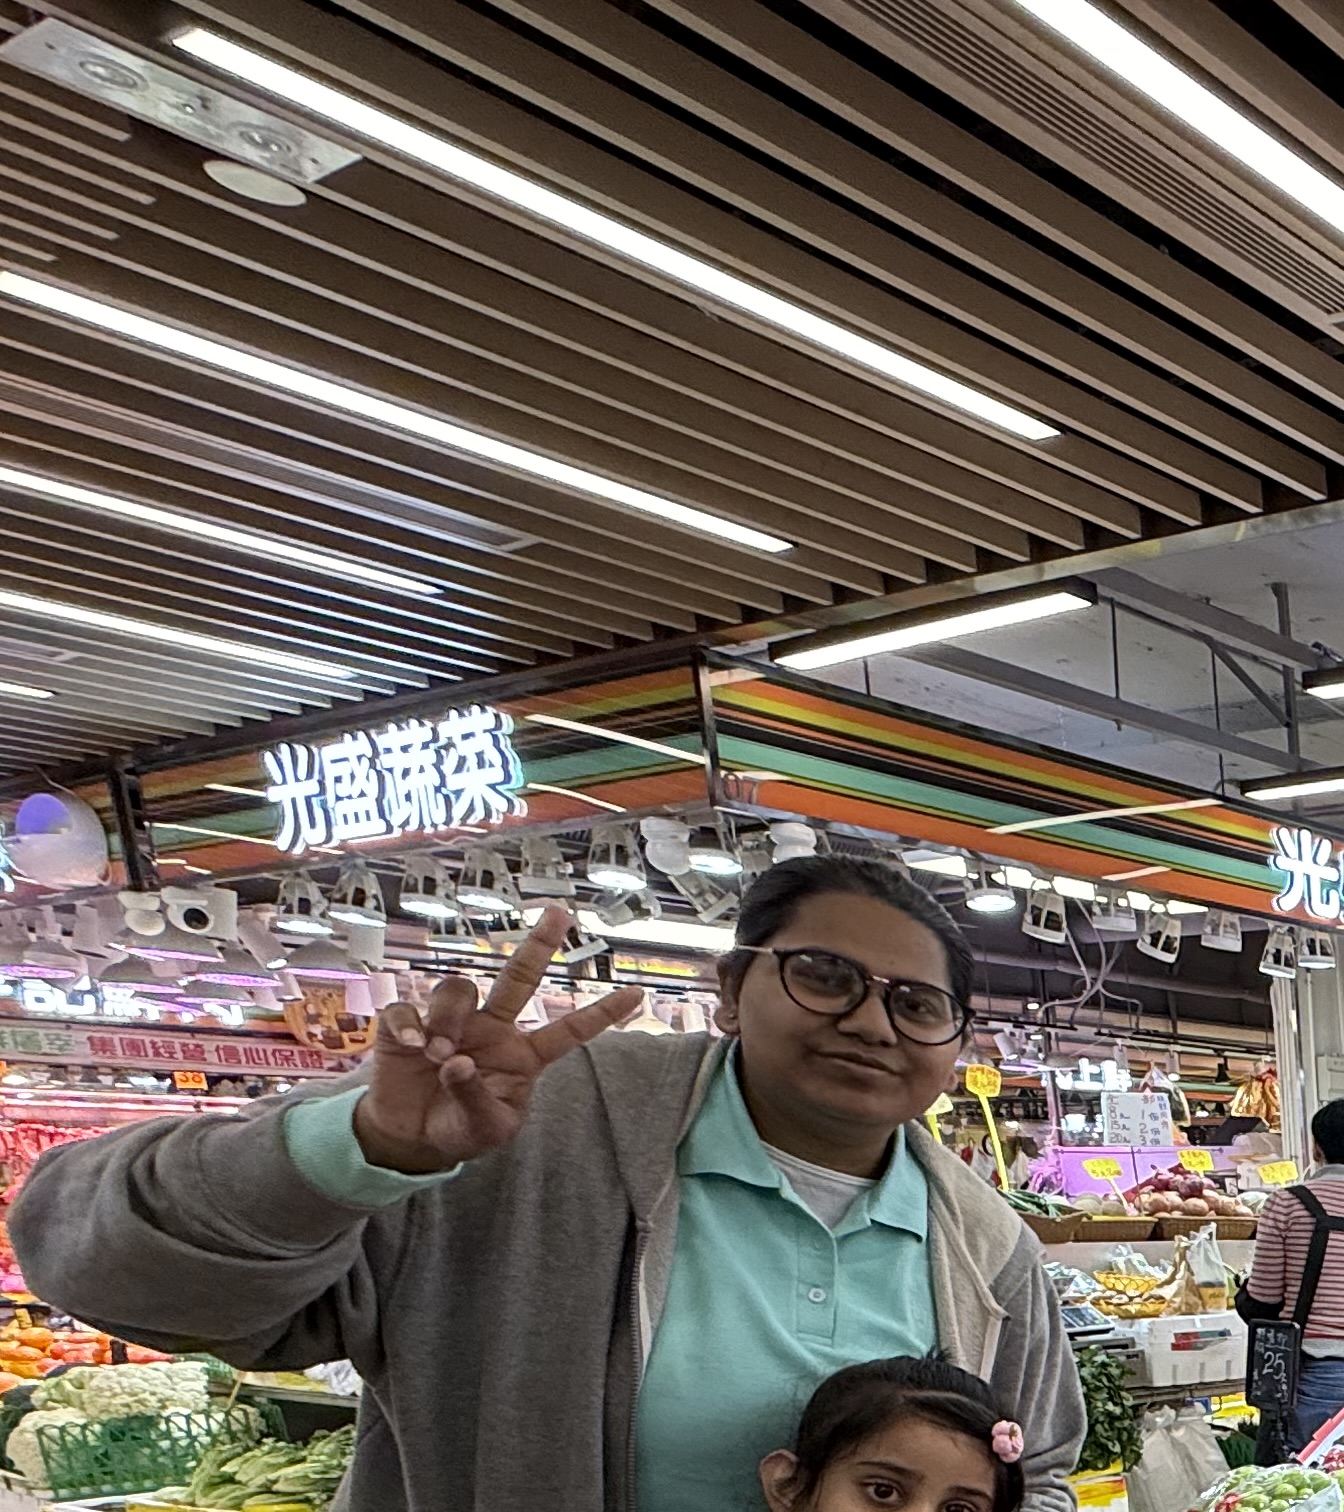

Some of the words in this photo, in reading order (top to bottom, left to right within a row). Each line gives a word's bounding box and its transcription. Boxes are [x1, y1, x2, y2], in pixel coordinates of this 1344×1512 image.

[266, 705, 528, 852] 光盛蔬菜
[88, 1034, 208, 1064] 集團經營
[214, 1045, 326, 1071] 信心保證
[1262, 1350, 1286, 1381] 25
